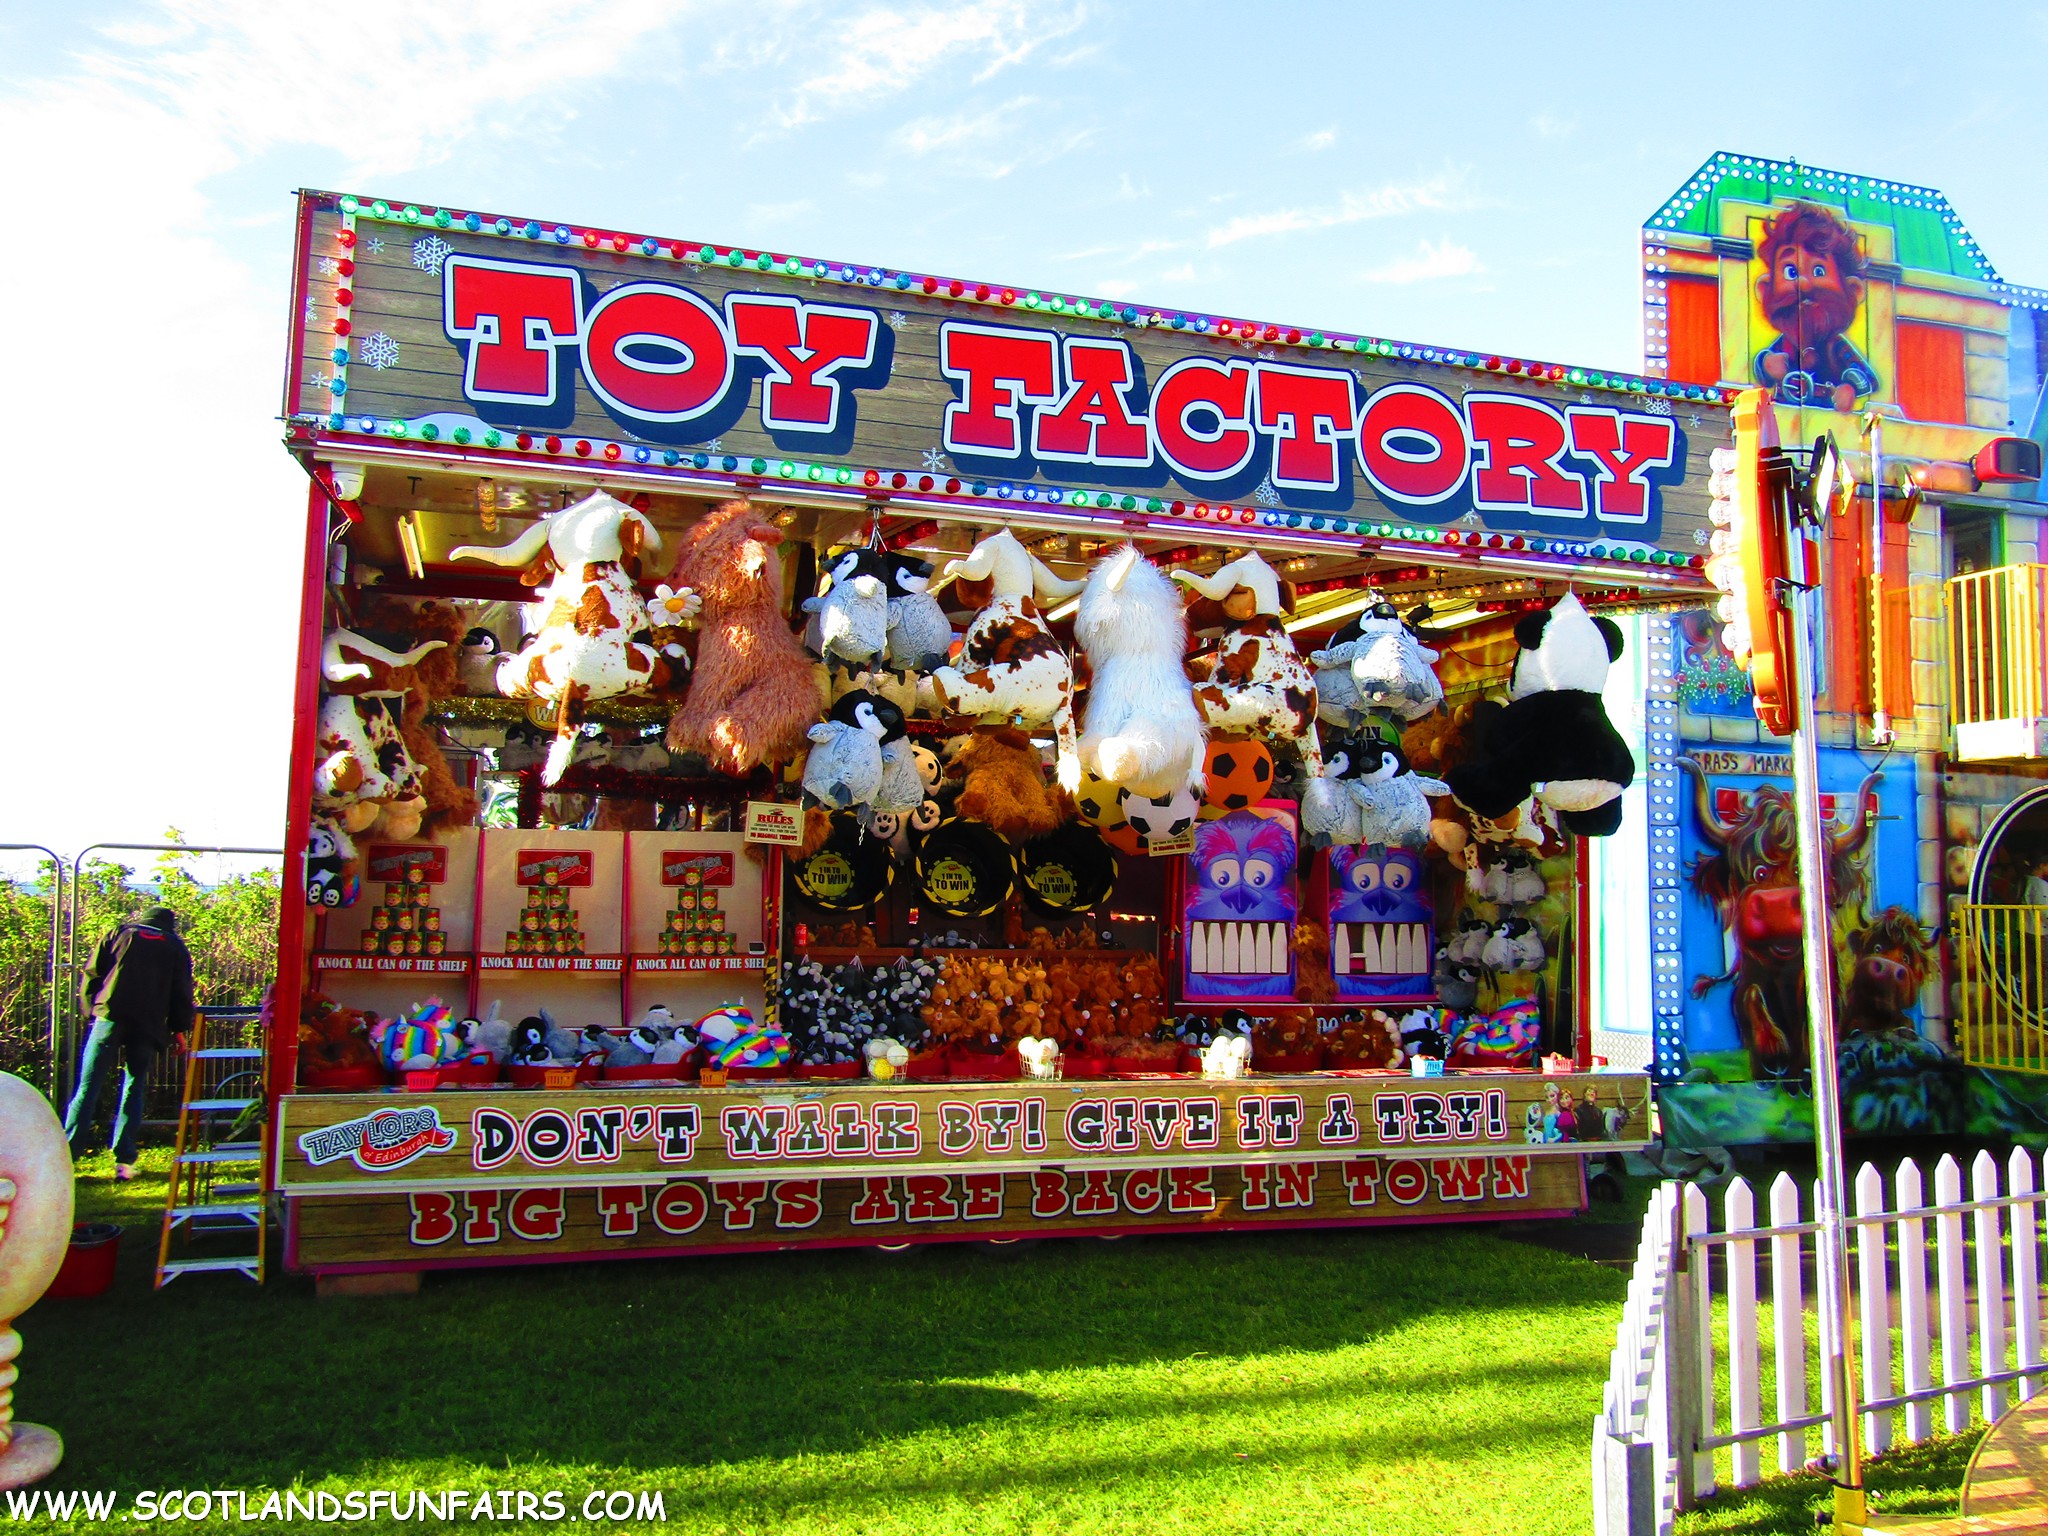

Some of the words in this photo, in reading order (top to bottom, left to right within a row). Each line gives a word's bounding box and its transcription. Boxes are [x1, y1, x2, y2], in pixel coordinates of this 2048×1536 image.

[443, 254, 882, 435] TOY
[939, 319, 1679, 526] FACTORY
[1753, 754, 1793, 772] MARK
[757, 814, 794, 825] RULES
[811, 872, 825, 884] TO
[827, 873, 848, 885] WIN
[935, 878, 947, 890] TO
[949, 880, 969, 891] WIN
[1037, 882, 1050, 893] TO
[1052, 883, 1071, 894] WIN
[317, 957, 352, 969] KNOCK
[355, 958, 374, 969] ALL
[377, 958, 396, 970] CAN
[399, 959, 413, 970] OF
[415, 959, 435, 971] THE
[438, 960, 468, 972] SHELF
[481, 957, 514, 968] KNOCK
[516, 957, 534, 969] ALL
[537, 958, 555, 969] CAN
[558, 958, 571, 969] OF
[573, 958, 593, 969] THE
[595, 959, 623, 970] SHELF
[636, 959, 667, 970] KNOCK
[670, 958, 686, 970] ALL
[689, 958, 706, 969] CAN
[709, 958, 721, 969] OF
[724, 958, 742, 968] THE
[744, 958, 767, 969] SHEL
[304, 1108, 436, 1161] TAYLORS
[473, 1103, 701, 1170] DON'T
[720, 1101, 919, 1160] WALK
[939, 1096, 1047, 1156] BY!
[1065, 1096, 1220, 1154] GIVE
[1236, 1093, 1303, 1149] IT
[1319, 1091, 1358, 1144] A
[1374, 1088, 1507, 1144] TRY!
[375, 1134, 428, 1163] Edinburgh
[409, 1188, 567, 1245] BIG
[598, 1179, 822, 1237] TOYS
[851, 1174, 1004, 1225] ARE
[1031, 1167, 1216, 1217] BACK
[1241, 1162, 1318, 1212] IN
[1341, 1155, 1533, 1206] TOWN
